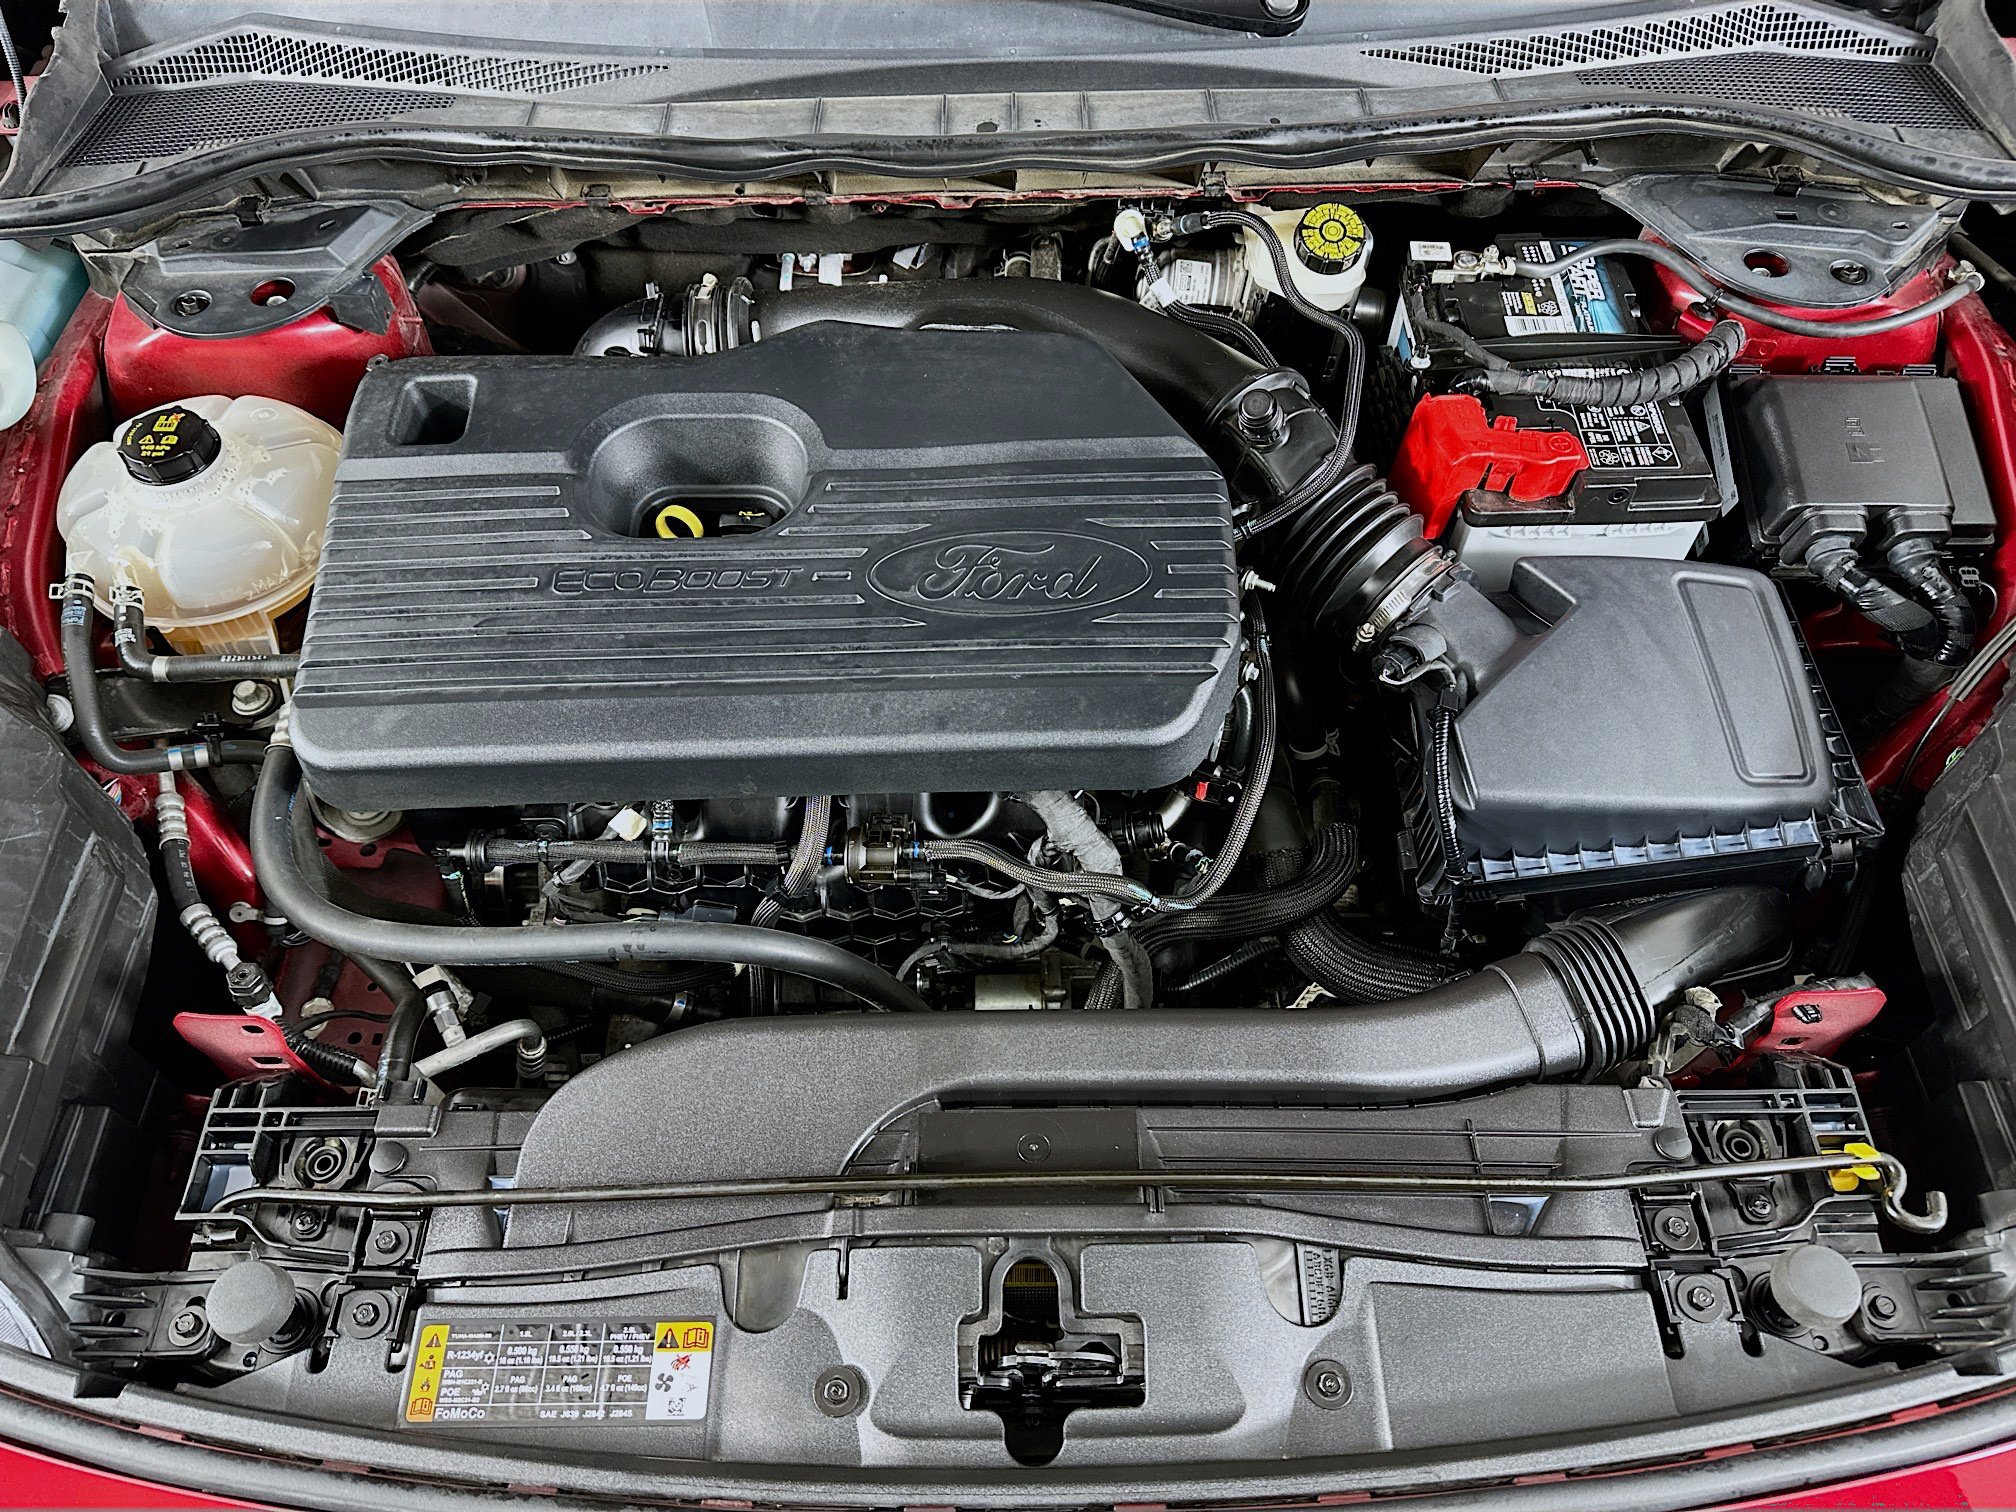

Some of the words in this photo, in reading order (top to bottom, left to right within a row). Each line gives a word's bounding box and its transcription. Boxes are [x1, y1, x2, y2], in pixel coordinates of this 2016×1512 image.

[916, 542, 1102, 601] Ford
[251, 570, 290, 594] MAX
[527, 1346, 538, 1357] kg
[580, 1344, 590, 1355] kg
[634, 1344, 644, 1355] kg
[446, 1350, 484, 1361] R-1234yf
[443, 1370, 464, 1378] PAG
[562, 1375, 578, 1383] PAG
[509, 1376, 526, 1384] PAG
[440, 1388, 461, 1396] POE
[434, 1406, 486, 1419] FoMoCo
[540, 1410, 557, 1418] SAE
